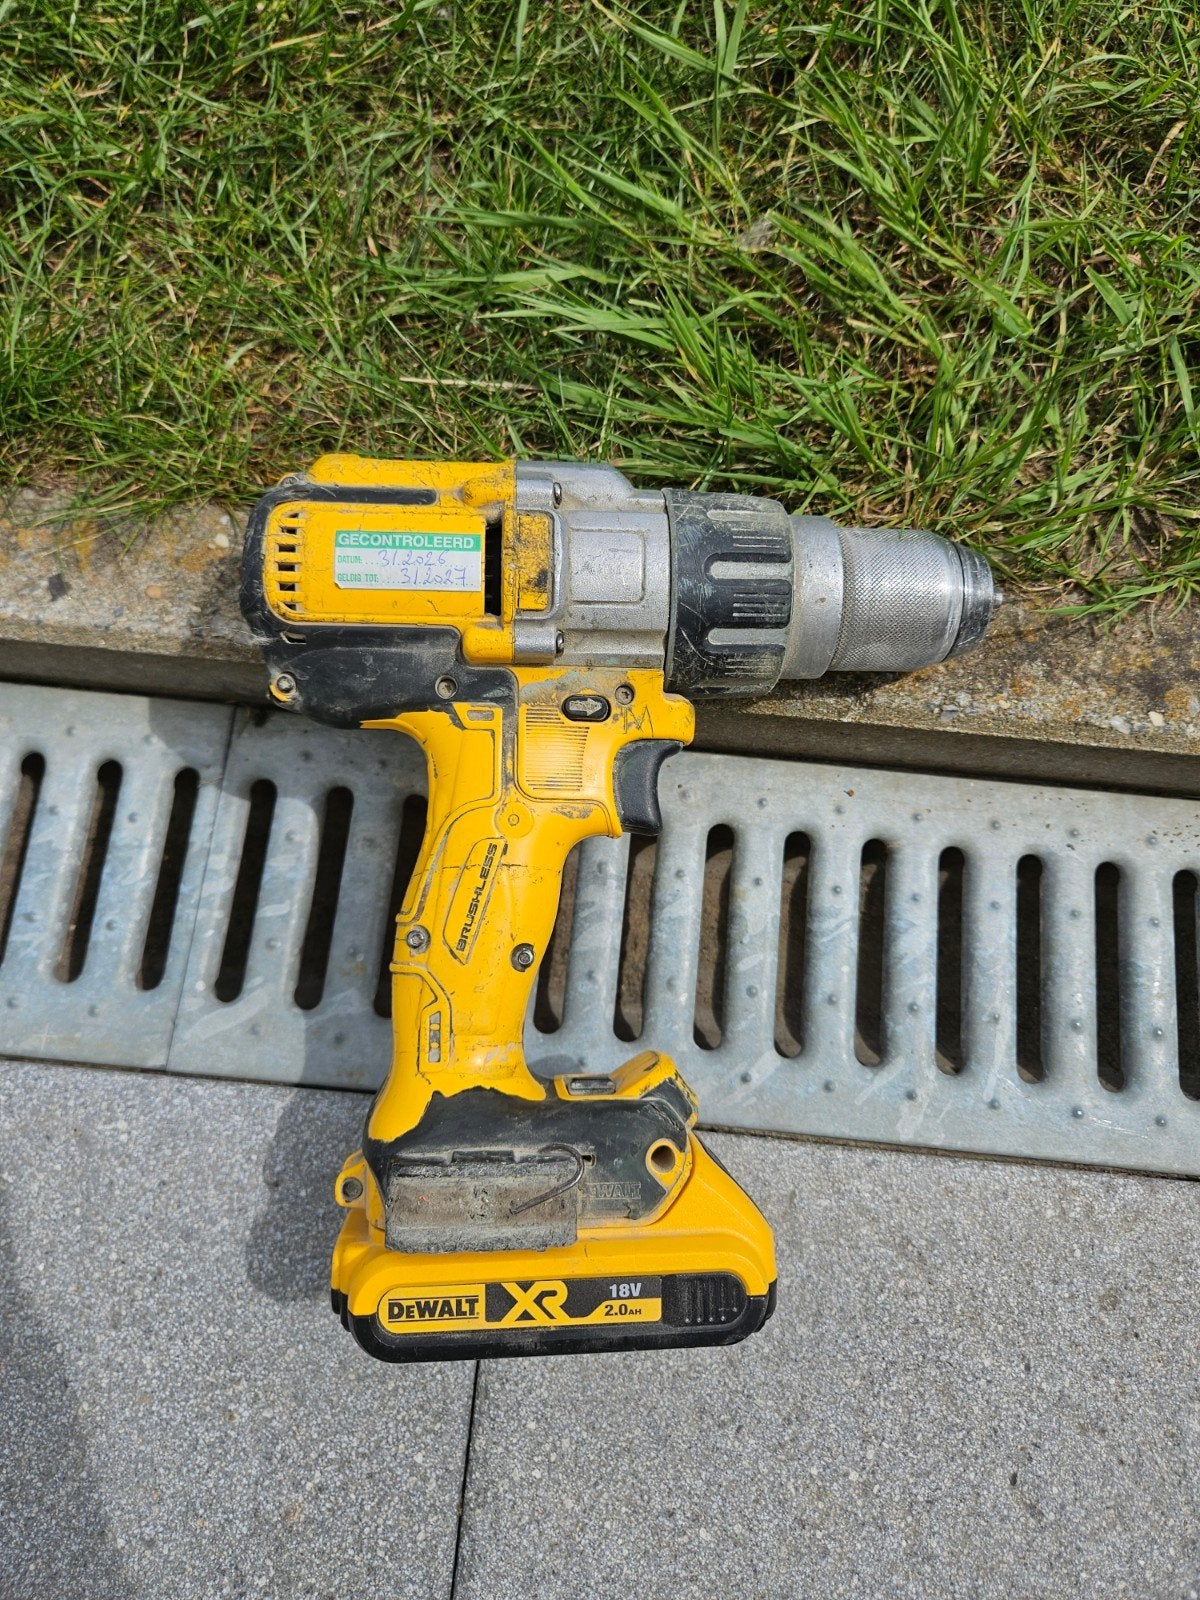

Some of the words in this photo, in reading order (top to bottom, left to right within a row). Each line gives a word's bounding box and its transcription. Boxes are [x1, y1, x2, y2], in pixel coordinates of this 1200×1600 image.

[338, 533, 474, 549] GECONTROLEERD
[337, 554, 363, 564] DATUM:
[337, 573, 362, 582] GELDIG
[364, 573, 379, 583] TOT:
[456, 842, 498, 952] BRUSHLESS
[609, 1282, 642, 1298] 18V
[501, 1280, 570, 1322] XR
